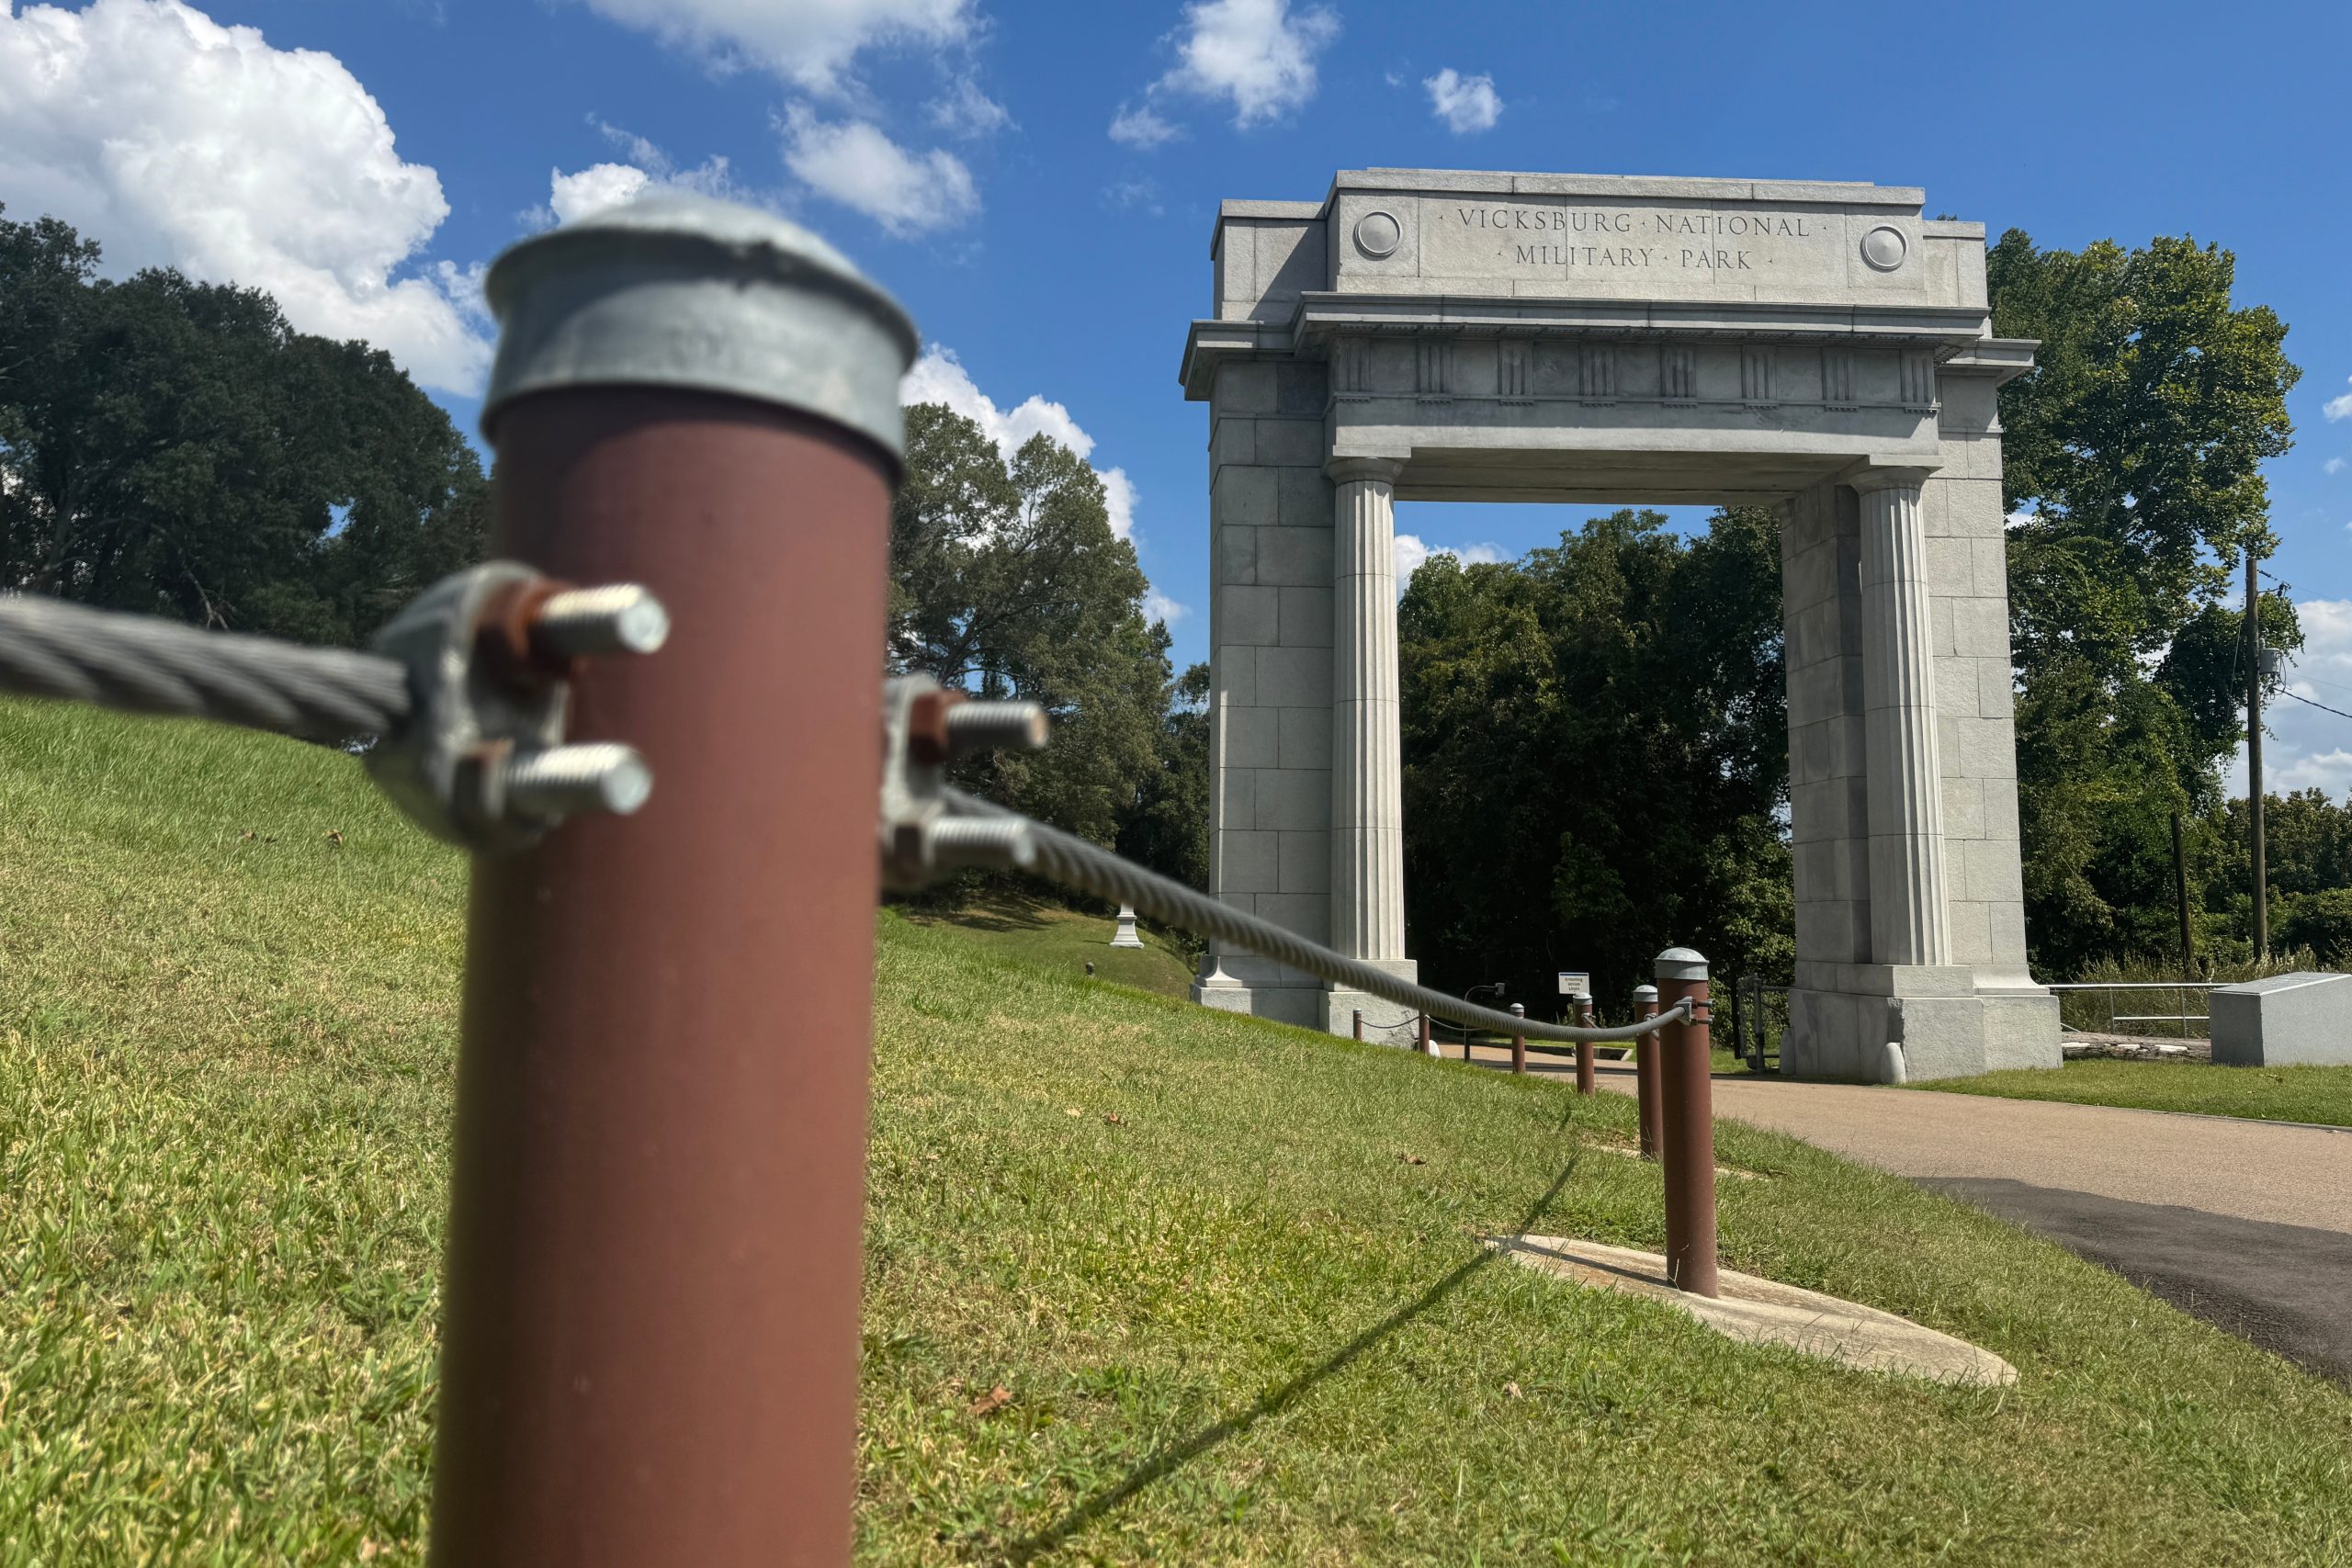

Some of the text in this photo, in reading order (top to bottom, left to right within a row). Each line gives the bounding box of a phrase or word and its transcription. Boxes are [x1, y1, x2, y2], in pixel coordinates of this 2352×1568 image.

[1458, 209, 1810, 237] VICKSBURG NATIONAL
[1516, 245, 1753, 270] MILITARY PARK
